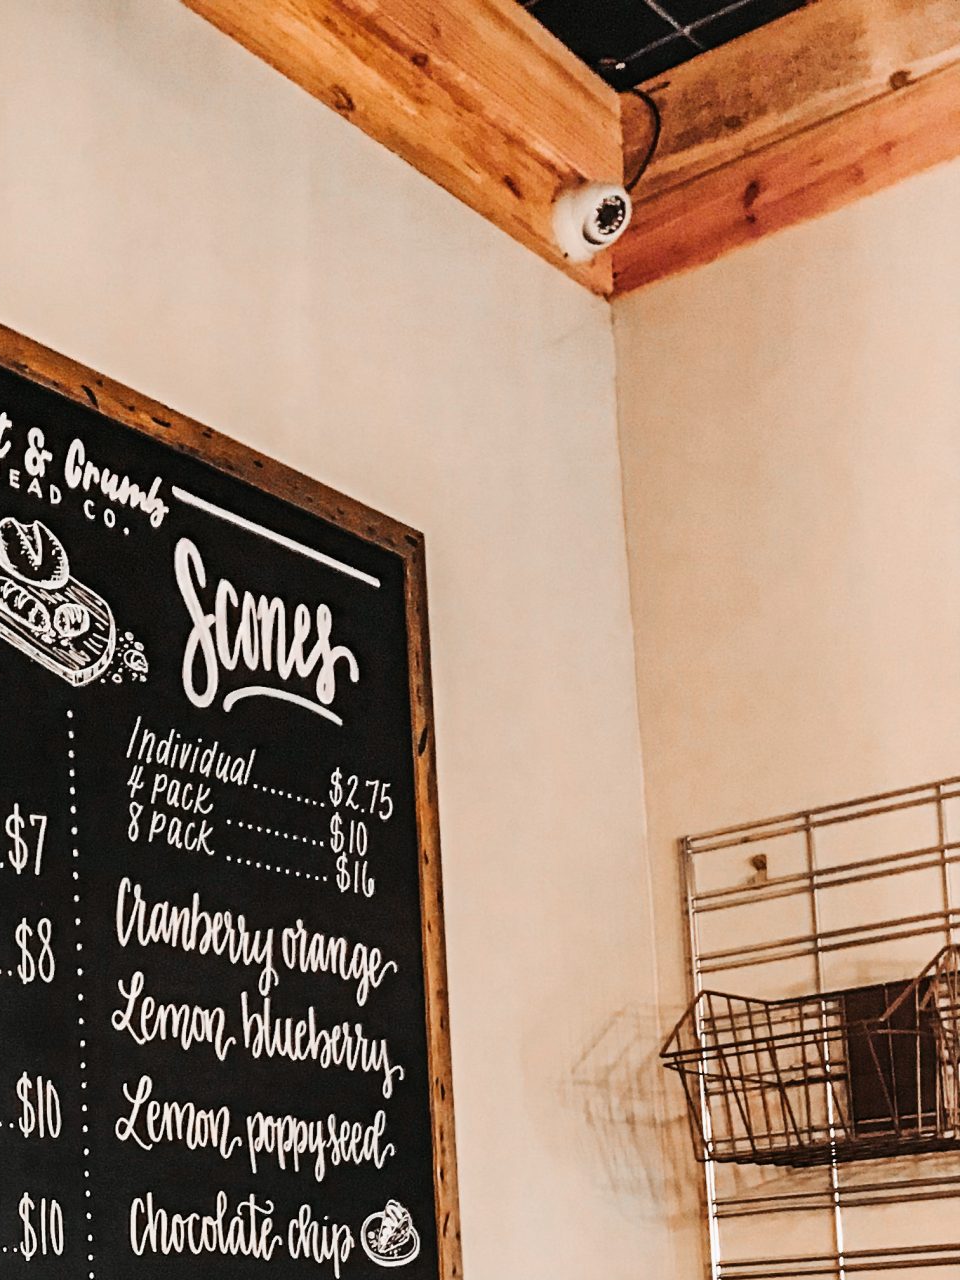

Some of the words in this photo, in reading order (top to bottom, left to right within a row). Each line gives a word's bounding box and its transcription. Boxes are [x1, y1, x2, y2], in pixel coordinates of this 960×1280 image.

[25, 427, 52, 477] &
[65, 439, 169, 528] Crumbs
[84, 500, 129, 535] CO.
[175, 538, 359, 708] Scones
[127, 716, 256, 785] Individual
[329, 767, 393, 820] $2.75
[127, 765, 144, 798] 4
[330, 812, 367, 856] $10
[5, 803, 47, 875] $7
[128, 802, 143, 841] 8
[336, 852, 374, 897] $16
[16, 918, 55, 984] $8
[116, 878, 278, 996] Cranberry
[282, 919, 397, 1006] orange
[111, 971, 236, 1061] Lemon
[241, 992, 404, 1099] blueberry
[18, 1071, 61, 1138] $10
[115, 1075, 242, 1159] Lemon
[247, 1110, 394, 1182] poppyseed
[19, 1192, 63, 1261] $10
[131, 1191, 282, 1261] Chocolate
[288, 1204, 354, 1279] chip
